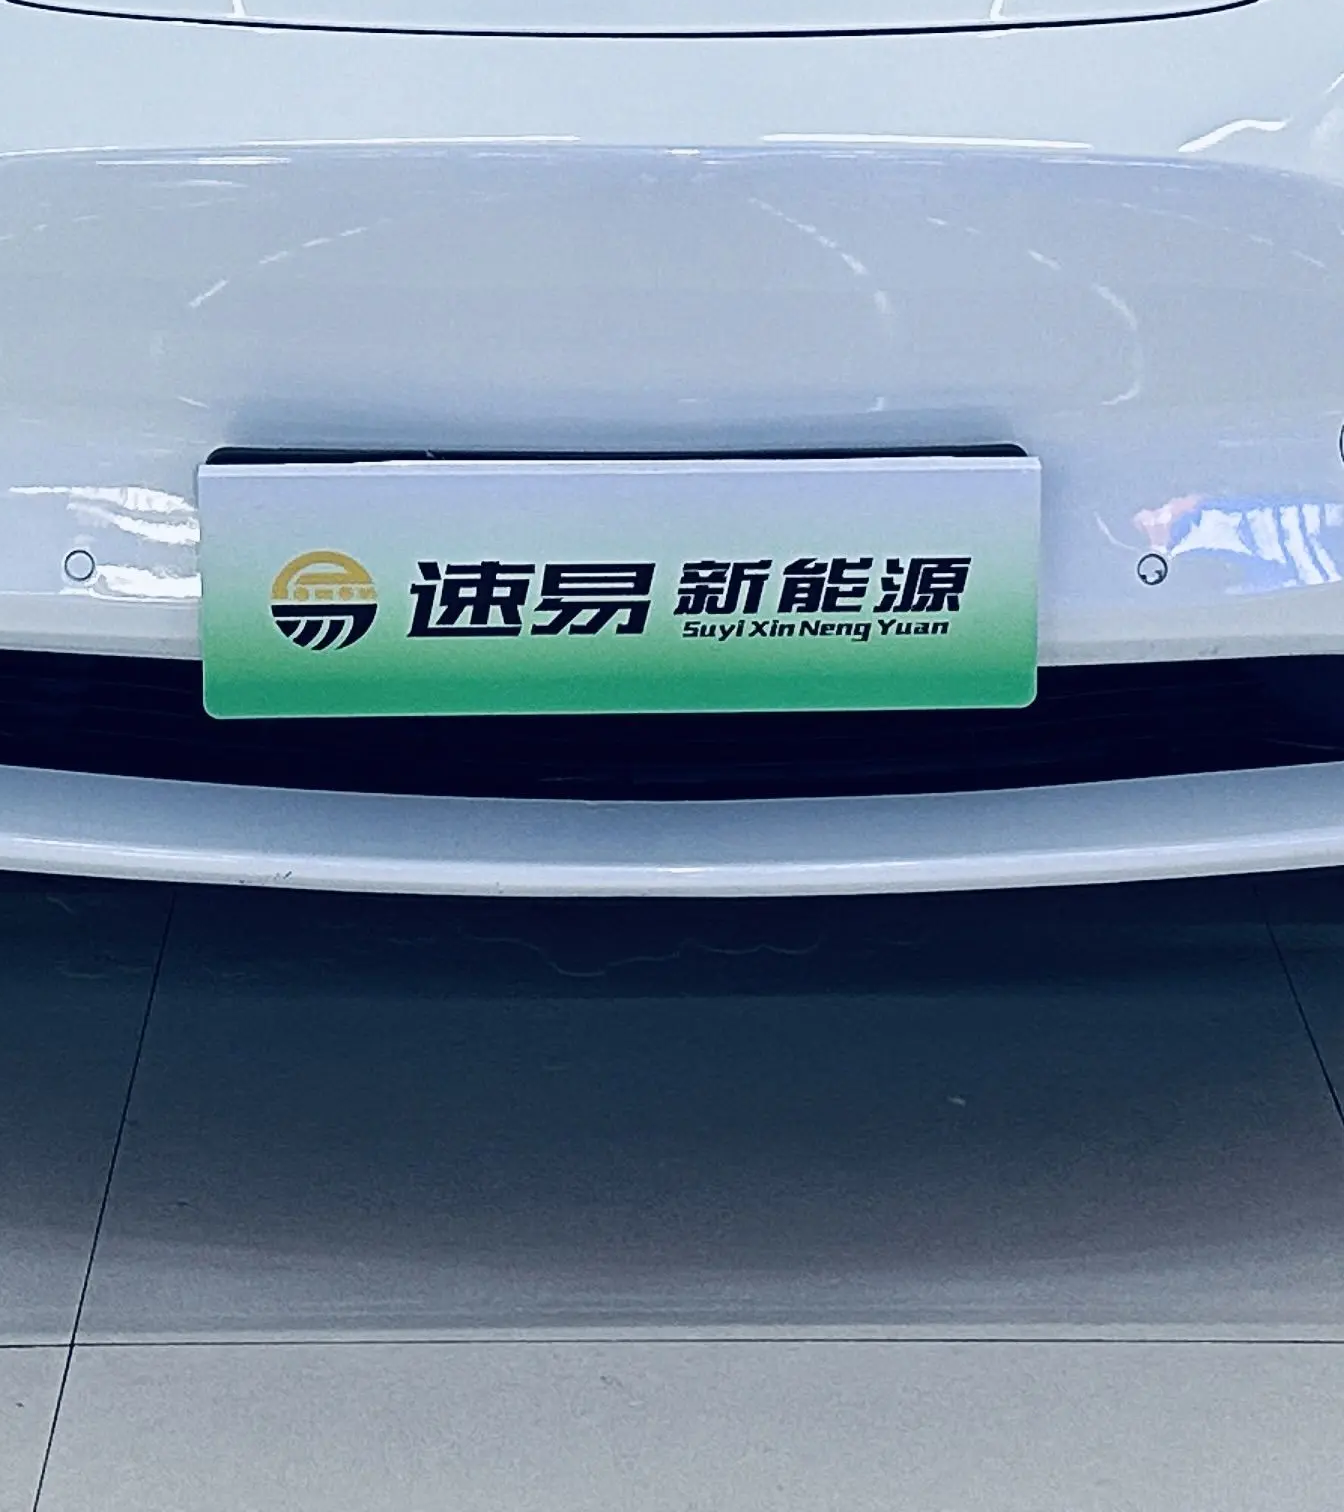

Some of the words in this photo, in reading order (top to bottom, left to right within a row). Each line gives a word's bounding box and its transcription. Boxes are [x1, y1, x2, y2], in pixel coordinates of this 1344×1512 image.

[407, 557, 972, 638] 速易新能源
[683, 620, 744, 642] Suyi
[749, 620, 795, 638] Xin
[799, 620, 871, 642] Neng
[877, 619, 950, 636] Yuan
